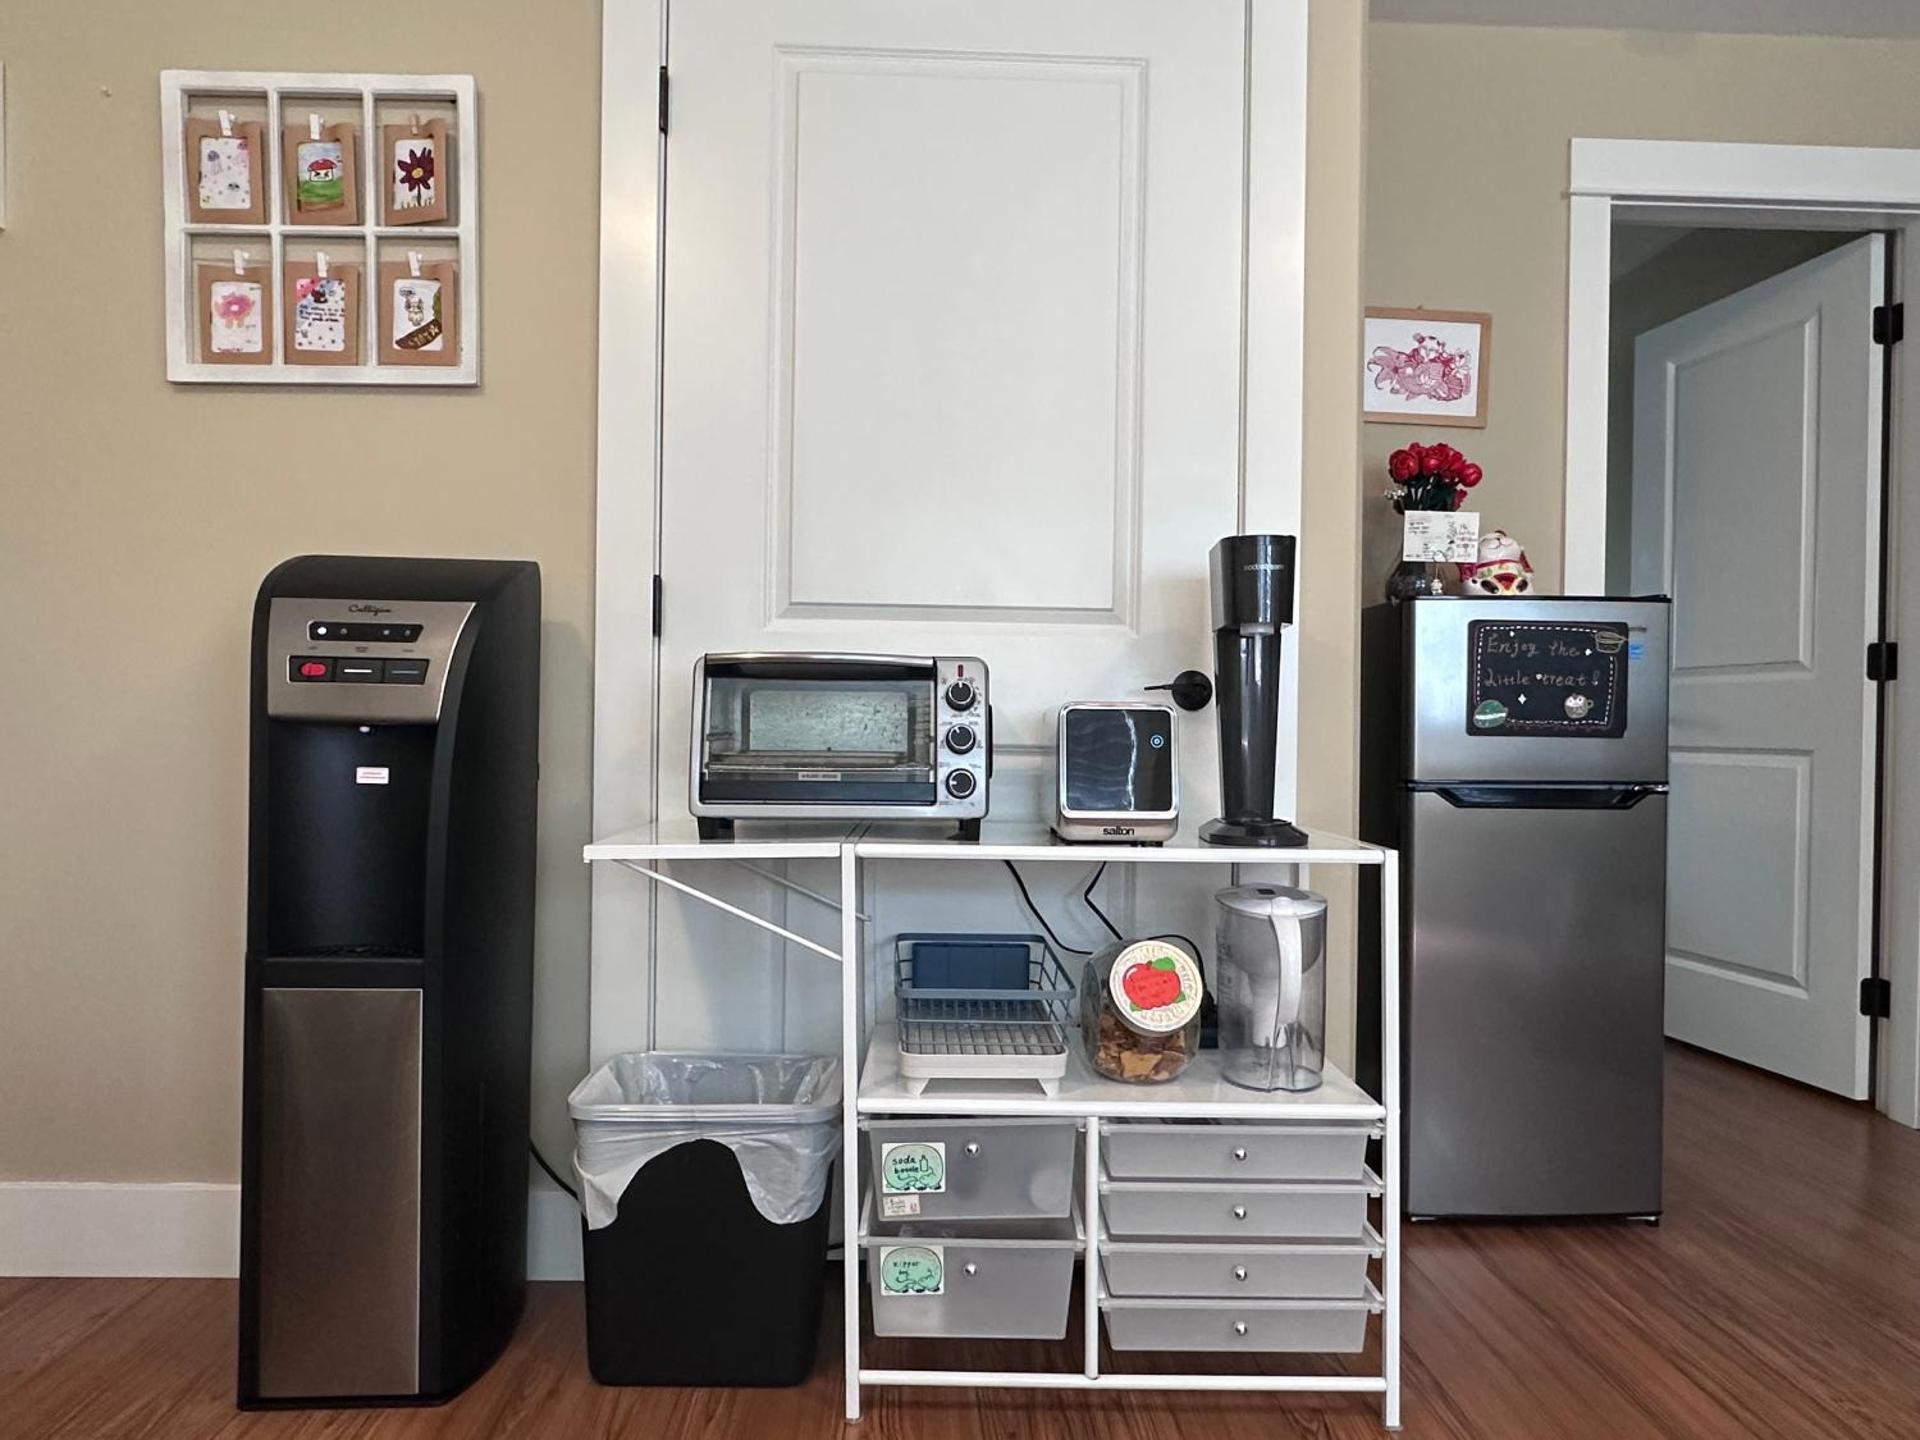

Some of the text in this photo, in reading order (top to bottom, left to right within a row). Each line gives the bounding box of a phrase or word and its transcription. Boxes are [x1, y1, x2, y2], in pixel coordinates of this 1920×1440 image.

[1486, 632, 1581, 658] Enjoy the
[1102, 825, 1135, 837] salton
[892, 1154, 917, 1166] soda
